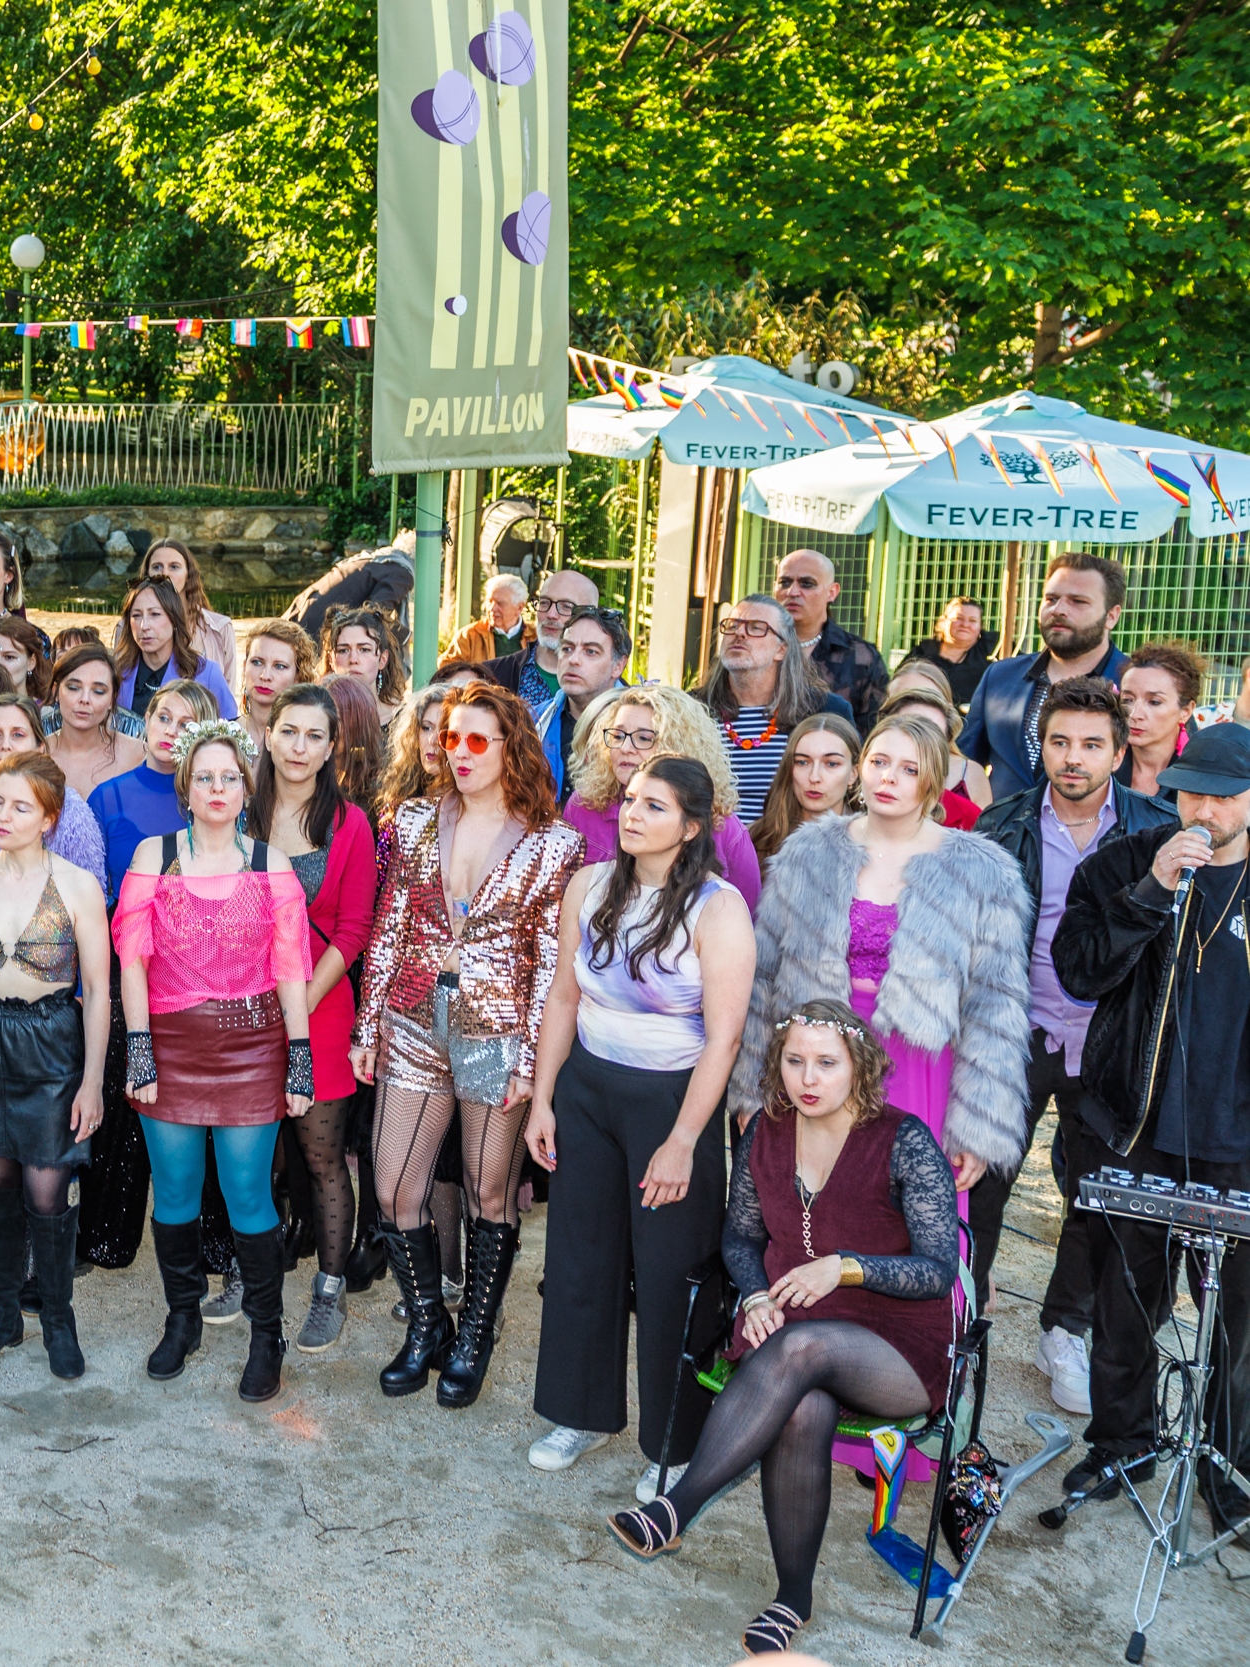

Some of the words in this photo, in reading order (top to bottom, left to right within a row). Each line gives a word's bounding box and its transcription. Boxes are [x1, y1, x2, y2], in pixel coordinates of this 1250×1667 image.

[403, 391, 545, 438] PAVILLON
[686, 442, 826, 461] FEVER-TRE
[926, 503, 1139, 531] FEVER-TREE
